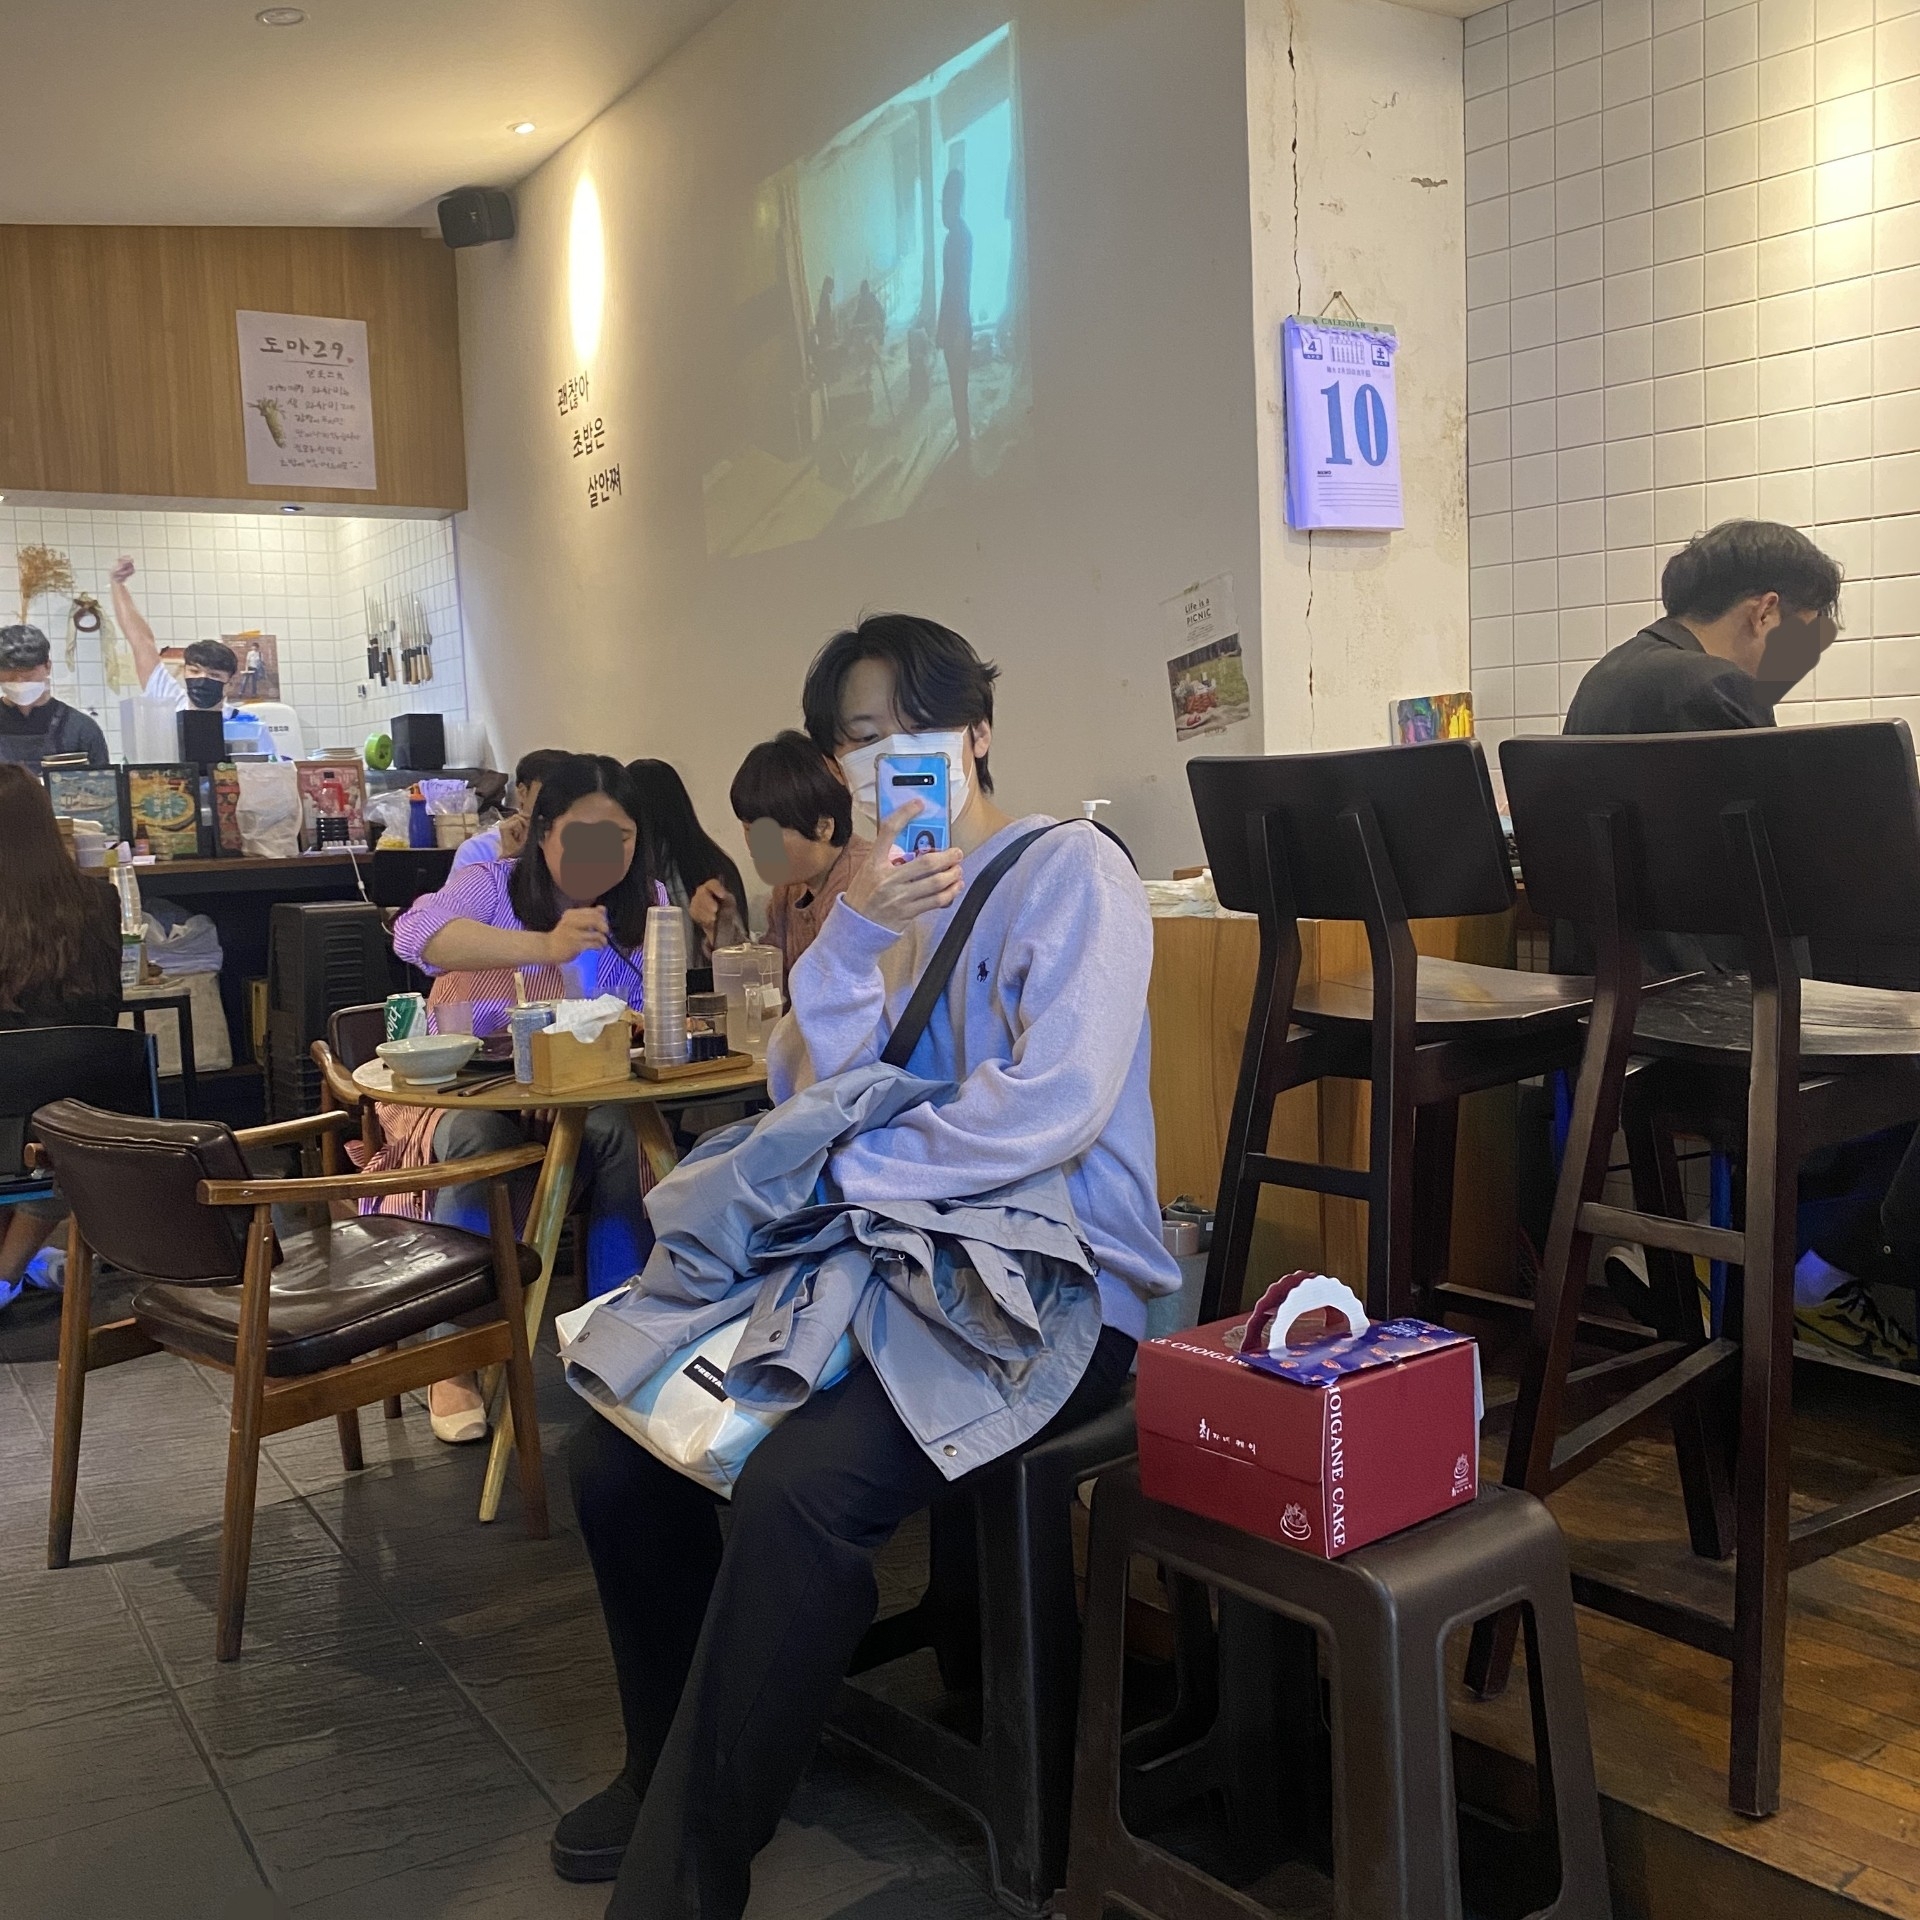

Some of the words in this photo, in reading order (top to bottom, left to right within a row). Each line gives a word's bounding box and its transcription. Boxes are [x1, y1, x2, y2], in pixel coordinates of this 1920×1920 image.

[1321, 318, 1366, 329] CALENDAR
[1308, 341, 1317, 352] 4
[557, 370, 589, 416] 괜찮아
[573, 417, 605, 459] 초밥은
[1320, 380, 1389, 467] 10
[588, 462, 622, 508] 살안쪄
[1185, 603, 1197, 614] Life
[1198, 599, 1205, 607] is
[1187, 609, 1211, 624] PICNIC
[1332, 1487, 1346, 1548] CAKE
